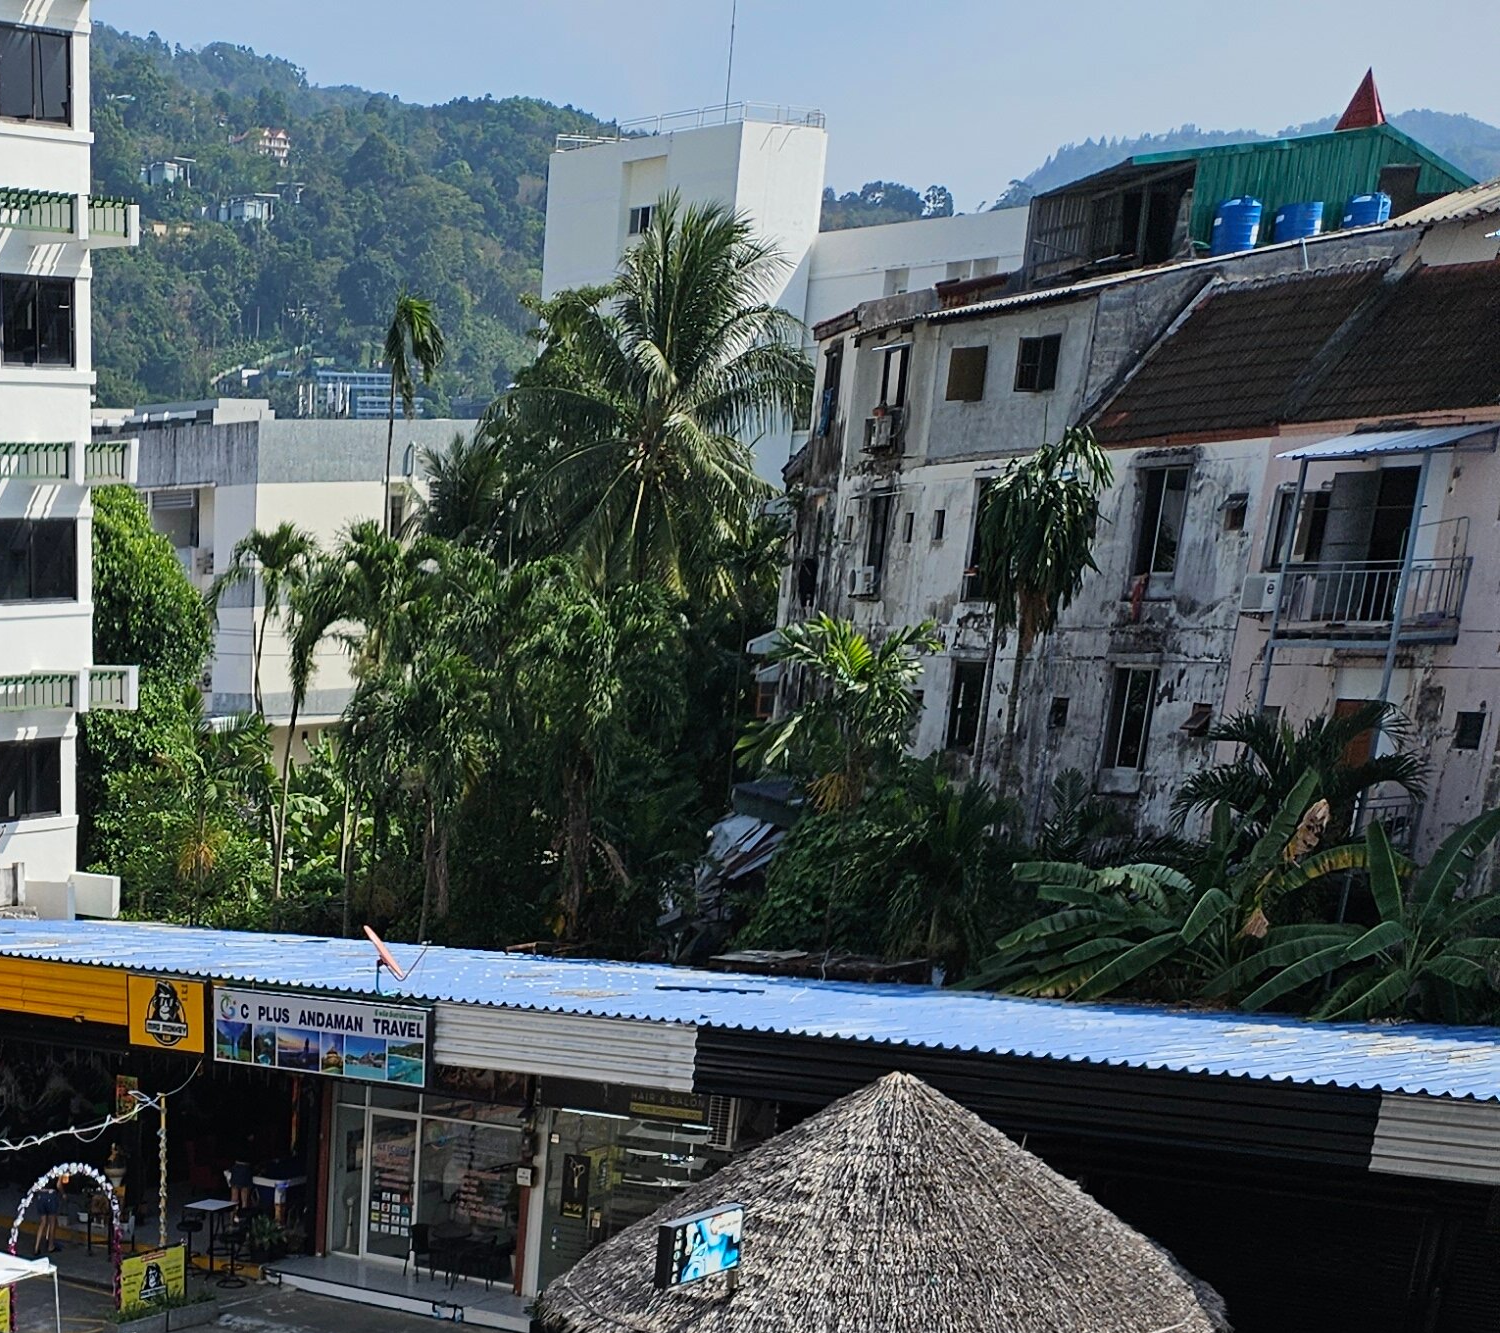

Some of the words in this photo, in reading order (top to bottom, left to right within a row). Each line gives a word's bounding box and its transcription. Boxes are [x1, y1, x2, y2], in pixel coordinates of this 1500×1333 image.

[241, 1003, 249, 1019] C
[258, 1006, 289, 1024] PLUS
[299, 1010, 363, 1032] ANDAMAN
[373, 1018, 423, 1038] TRAVEL
[631, 1091, 655, 1102] HAIR
